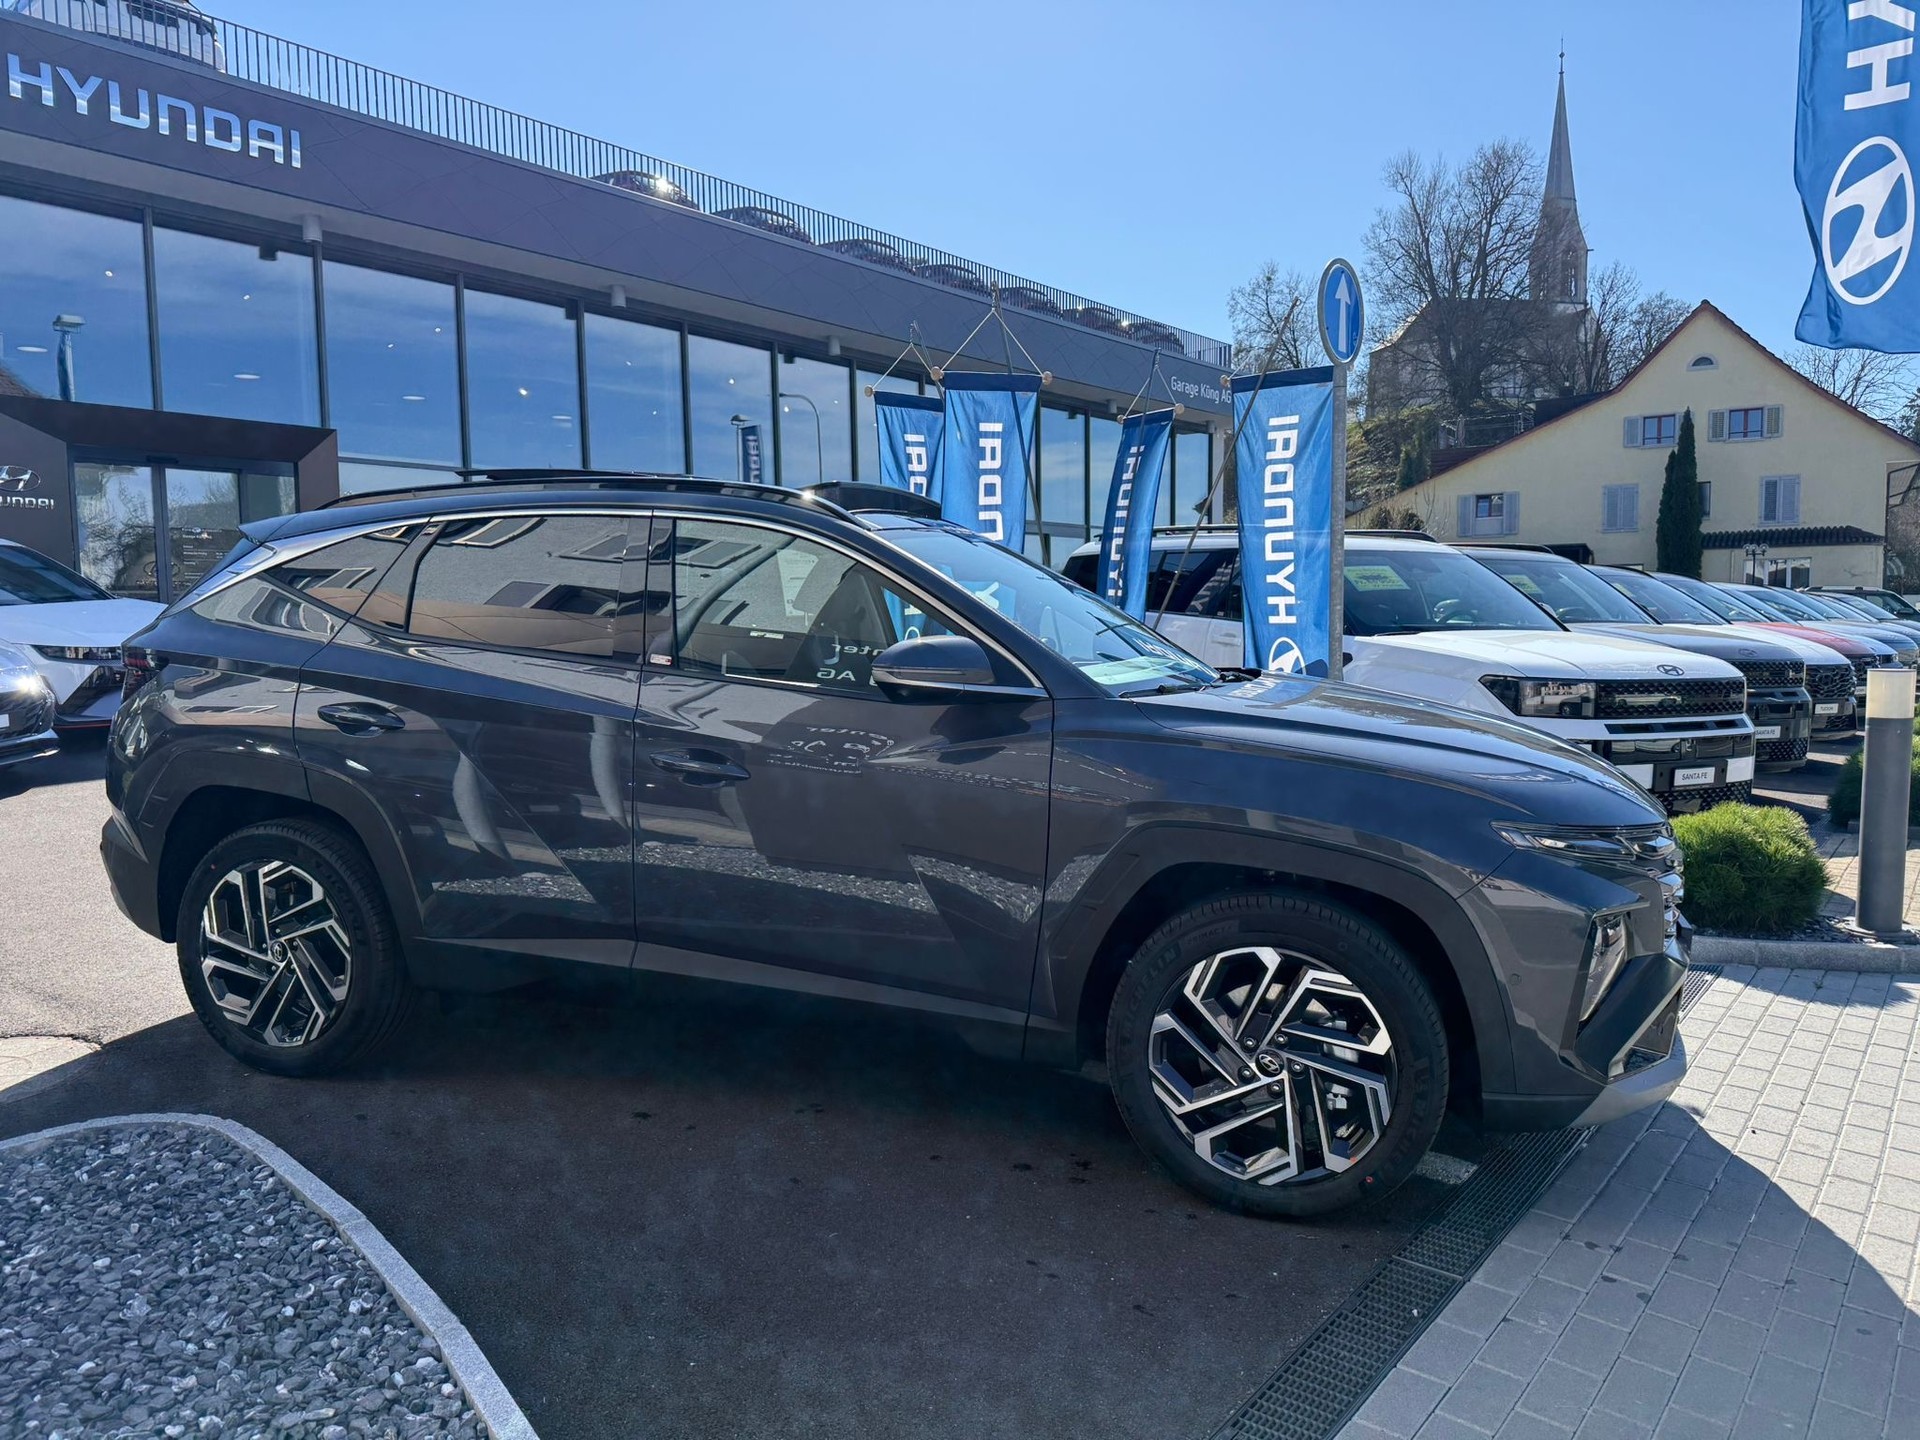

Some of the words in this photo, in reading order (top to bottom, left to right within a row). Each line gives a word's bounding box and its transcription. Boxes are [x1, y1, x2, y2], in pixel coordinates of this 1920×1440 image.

[7, 53, 302, 169] HYUNDAI
[1171, 376, 1199, 398] Garage
[1200, 383, 1220, 404] Küng
[1221, 389, 1232, 404] AG
[1681, 772, 1700, 781] SANTA
[1700, 771, 1708, 779] FE
